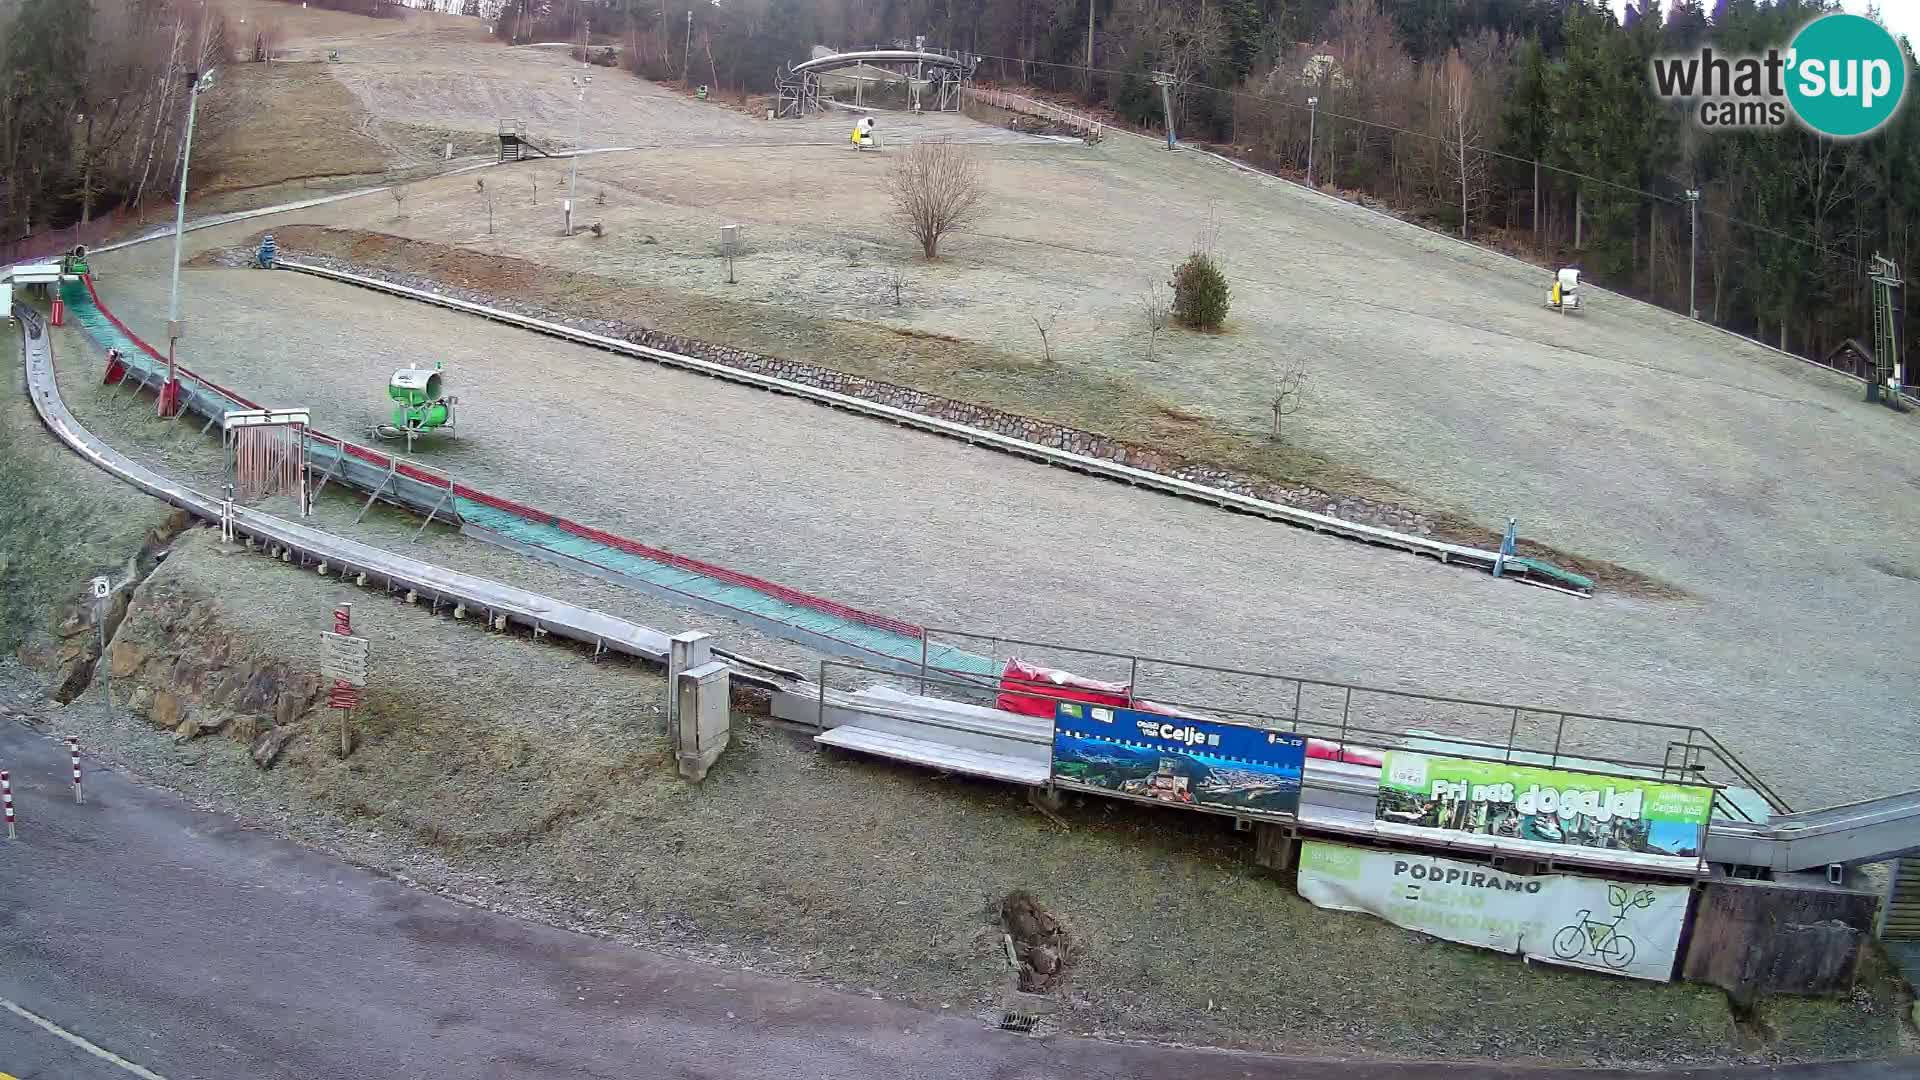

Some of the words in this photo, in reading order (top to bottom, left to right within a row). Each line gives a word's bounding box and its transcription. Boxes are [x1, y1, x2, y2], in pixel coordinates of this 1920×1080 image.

[1160, 723, 1206, 746] Celje
[1431, 779, 1468, 801] Pri
[1472, 782, 1515, 803] nas
[1394, 860, 1541, 894] PODPIRAMO
